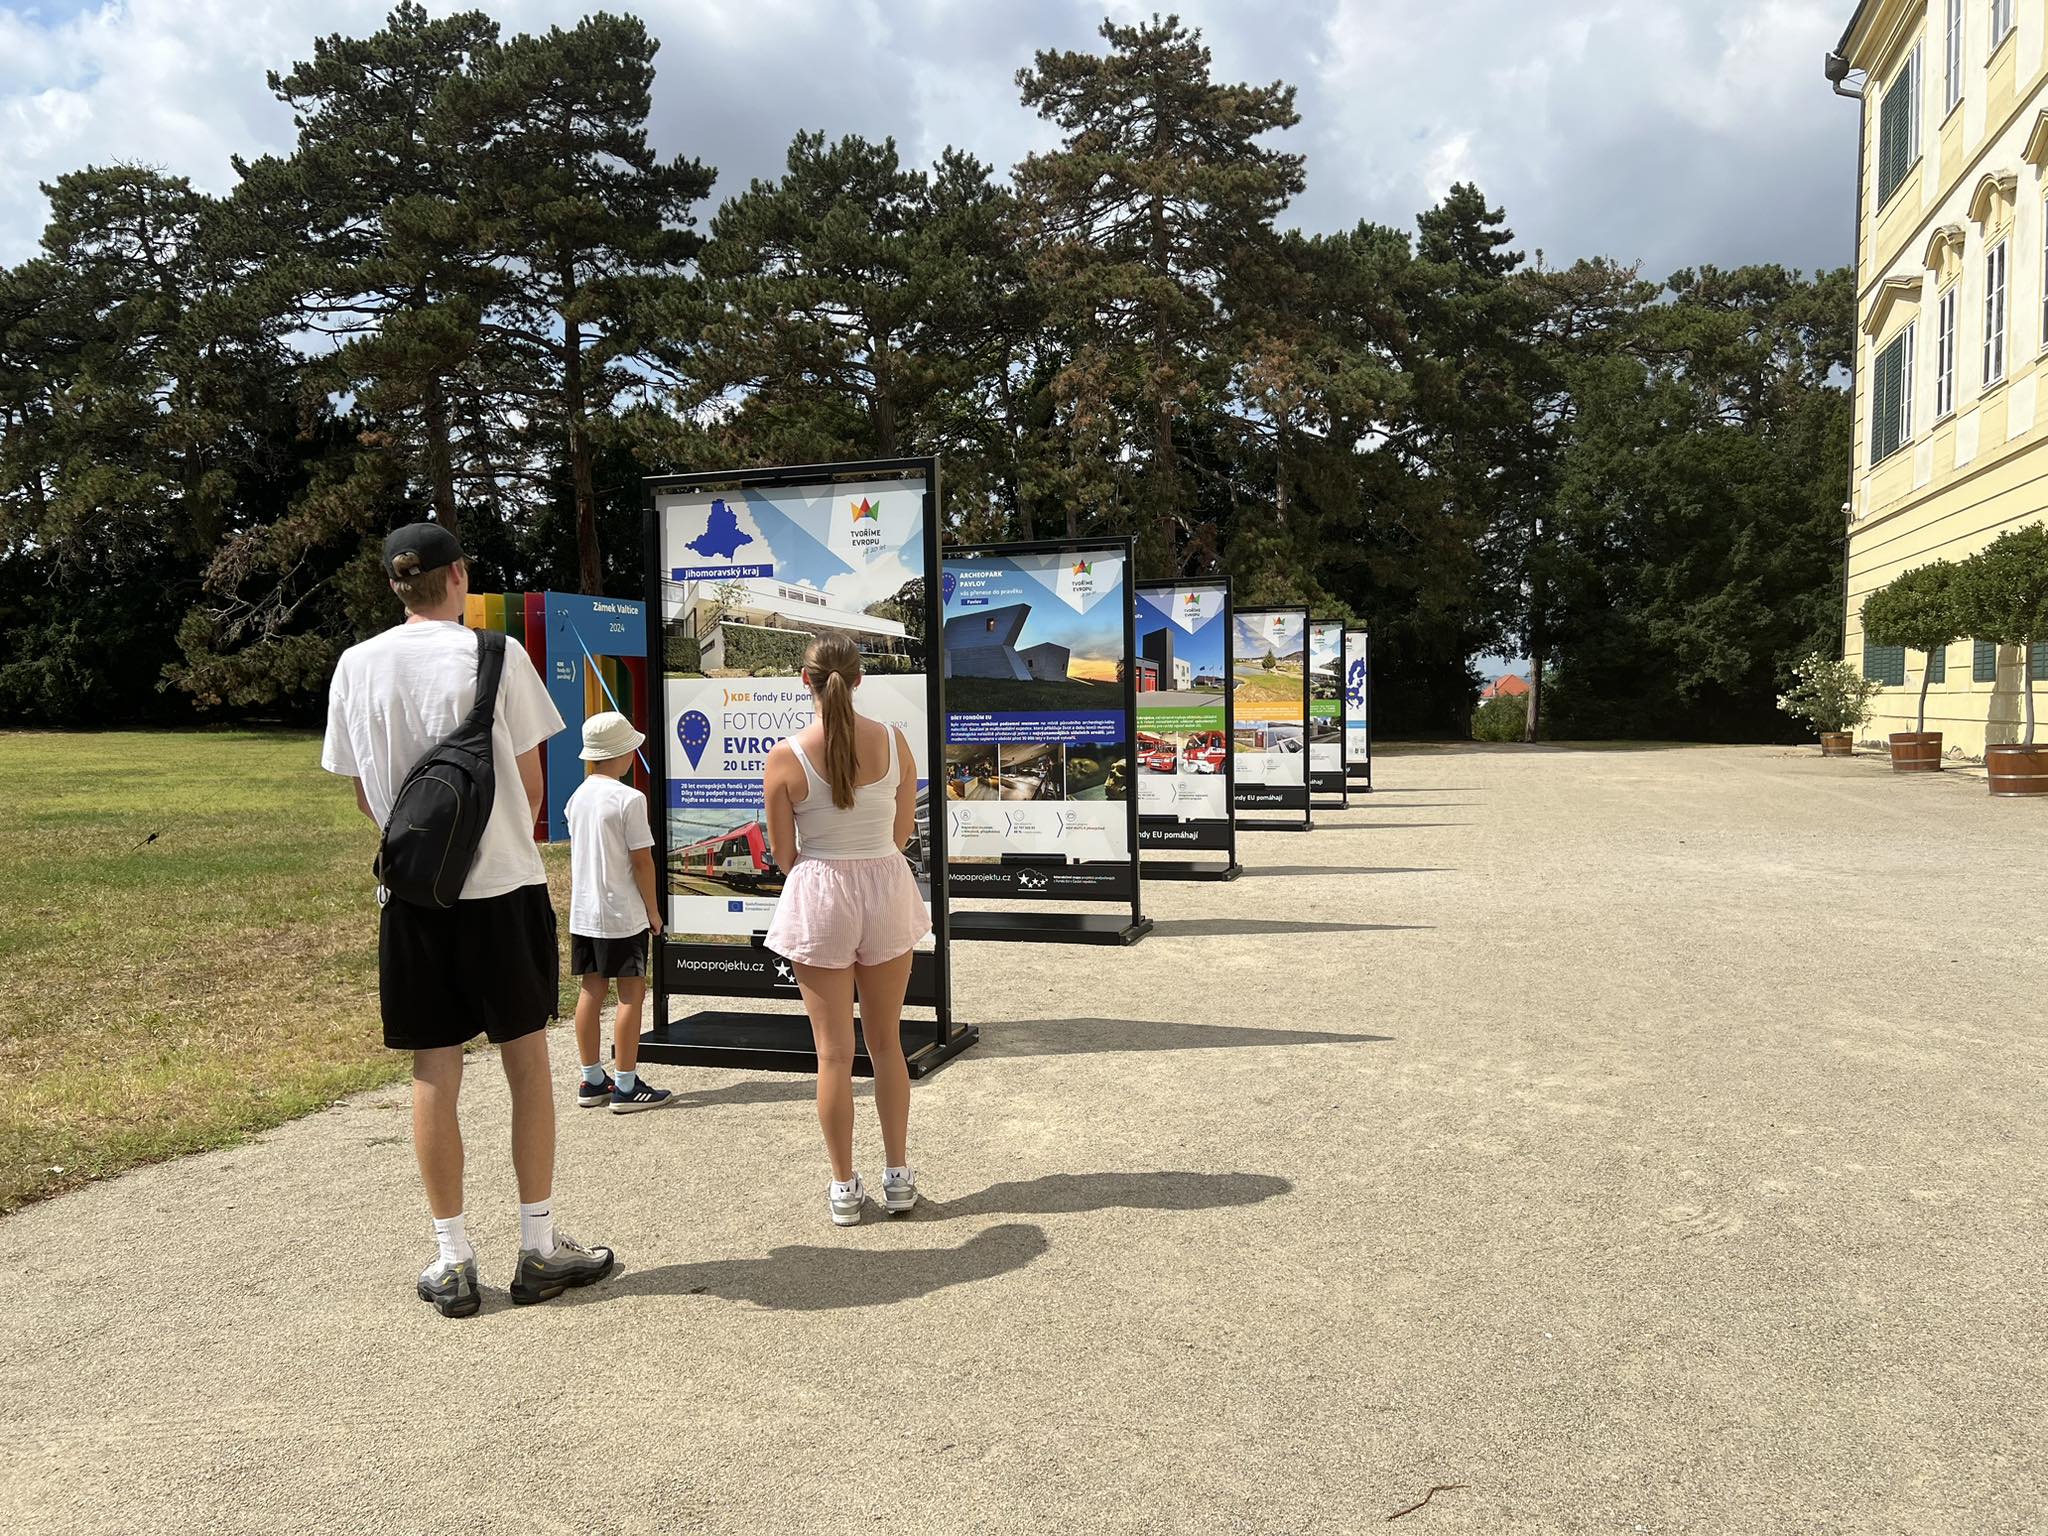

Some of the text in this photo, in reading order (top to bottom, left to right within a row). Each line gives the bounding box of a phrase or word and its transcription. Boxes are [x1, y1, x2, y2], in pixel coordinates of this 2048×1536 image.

[851, 528, 881, 537] TVOŘÍME
[684, 567, 760, 579] Jihomoravský kraj
[960, 571, 1003, 579] ARCHEOPARK
[592, 602, 639, 615] Zámek Valtice
[609, 623, 625, 632] 2024
[731, 692, 812, 703] KDE fondy EU pom
[723, 707, 816, 730] FOTOVÝST
[723, 737, 786, 754] EVRO
[723, 760, 765, 771] 20 LET:
[1152, 831, 1163, 839] EU
[1164, 830, 1199, 841] pomáhají
[948, 873, 1011, 882] Mapaprojektu.cz
[676, 959, 765, 973] Mapaprojektu.cz
